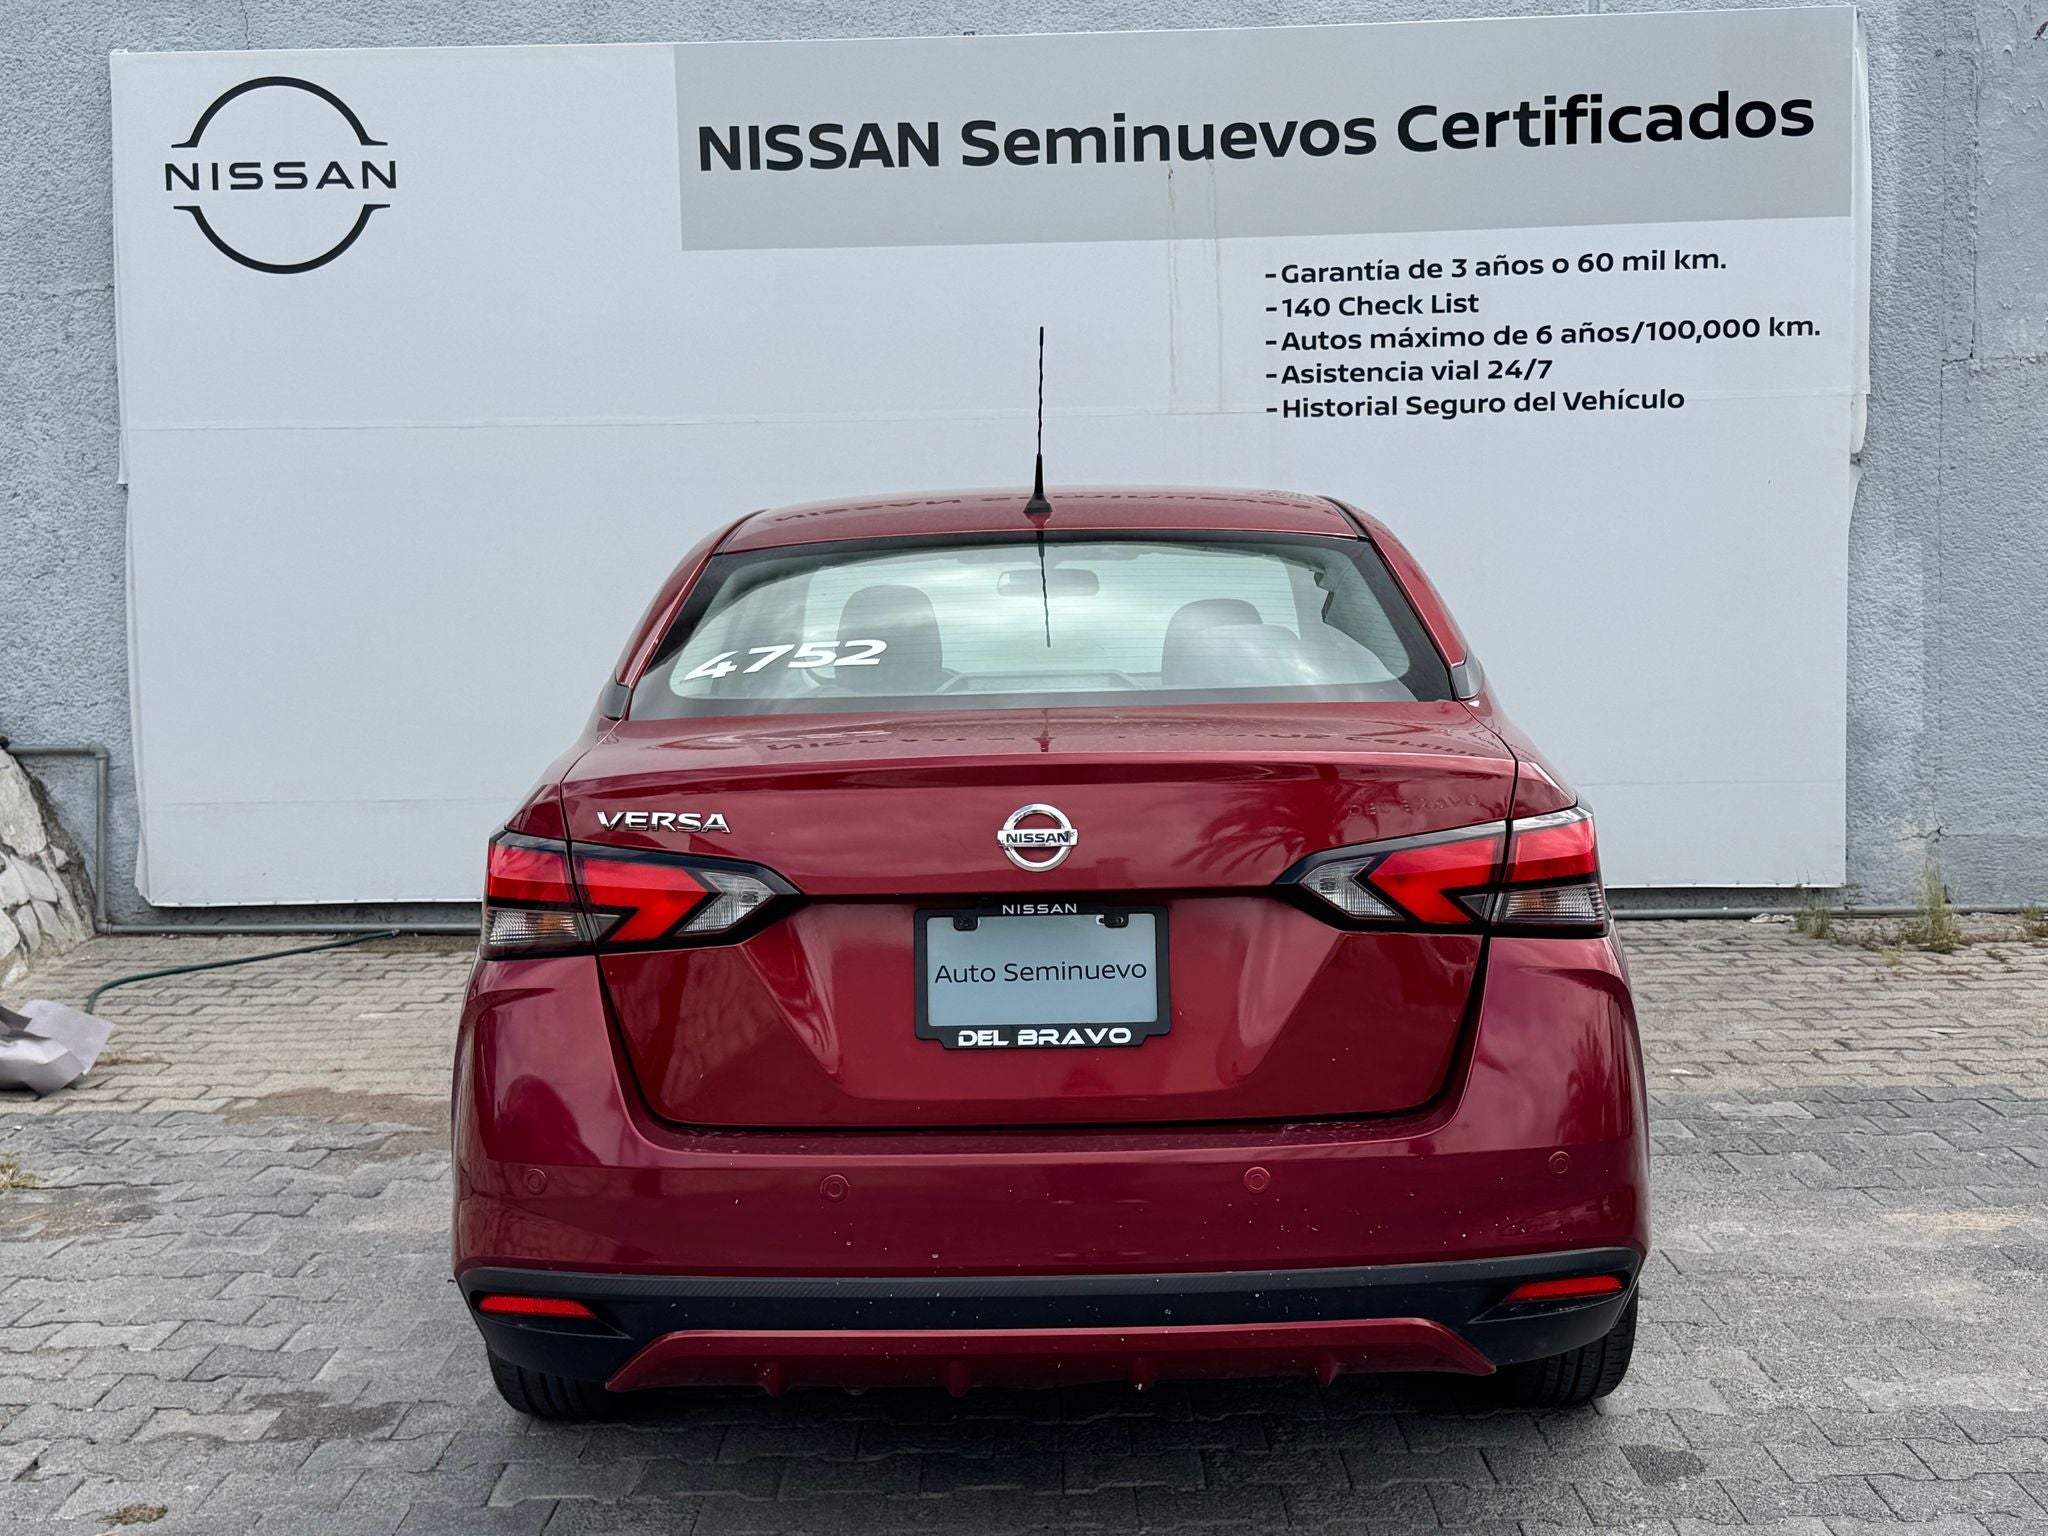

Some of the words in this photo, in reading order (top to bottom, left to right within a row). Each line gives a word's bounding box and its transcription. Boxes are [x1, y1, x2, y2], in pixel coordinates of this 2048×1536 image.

[699, 121, 940, 172] NISSAN
[962, 112, 1377, 167] Seminuevos
[1398, 91, 1815, 153] Certificados
[165, 160, 397, 191] NISSAN
[1409, 259, 1443, 280] de
[1452, 259, 1467, 278] 3
[1476, 255, 1544, 278] años
[1553, 259, 1570, 274] o
[1578, 253, 1614, 273] 60
[1623, 250, 1666, 272] mil
[1675, 250, 1726, 271] km.
[1339, 295, 1424, 317] Check
[1432, 293, 1480, 314] List
[1371, 326, 1485, 349] máximo
[1494, 326, 1528, 346] de
[1537, 325, 1552, 344] 6
[1561, 318, 1761, 344] años/100,000
[1770, 317, 1820, 337] km.
[1431, 359, 1479, 381] vial
[1488, 358, 1553, 381] 24/7
[1407, 396, 1506, 420] Seguro
[1514, 392, 1556, 412] del
[1563, 389, 1685, 411] Vehículo
[682, 639, 888, 681] 4752
[596, 811, 732, 833] VERSA
[1005, 831, 1070, 844] NISSAN
[1002, 903, 1078, 914] NISSAN
[934, 963, 996, 984] Auto
[1003, 960, 1147, 983] Seminuevo
[957, 1029, 1010, 1047] DEL
[1017, 1027, 1132, 1046] BRAVO
